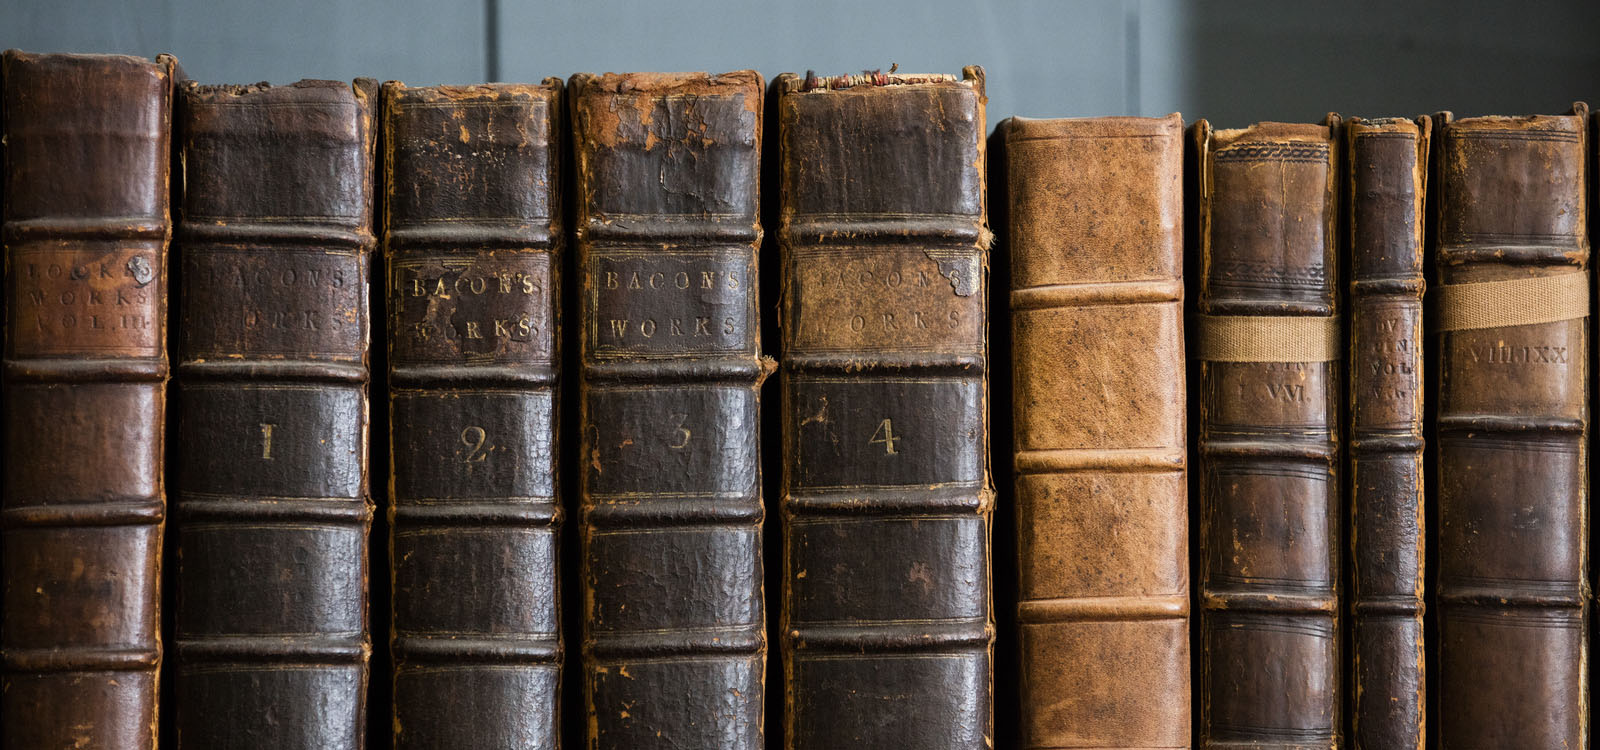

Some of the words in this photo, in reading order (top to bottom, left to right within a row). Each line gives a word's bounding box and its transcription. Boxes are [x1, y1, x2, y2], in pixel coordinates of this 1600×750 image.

[605, 270, 740, 290] BACON'S
[29, 290, 148, 306] WORKS
[610, 316, 736, 338] WORKS
[461, 425, 487, 463] 2
[668, 412, 692, 449] 3
[868, 418, 898, 456] 4
